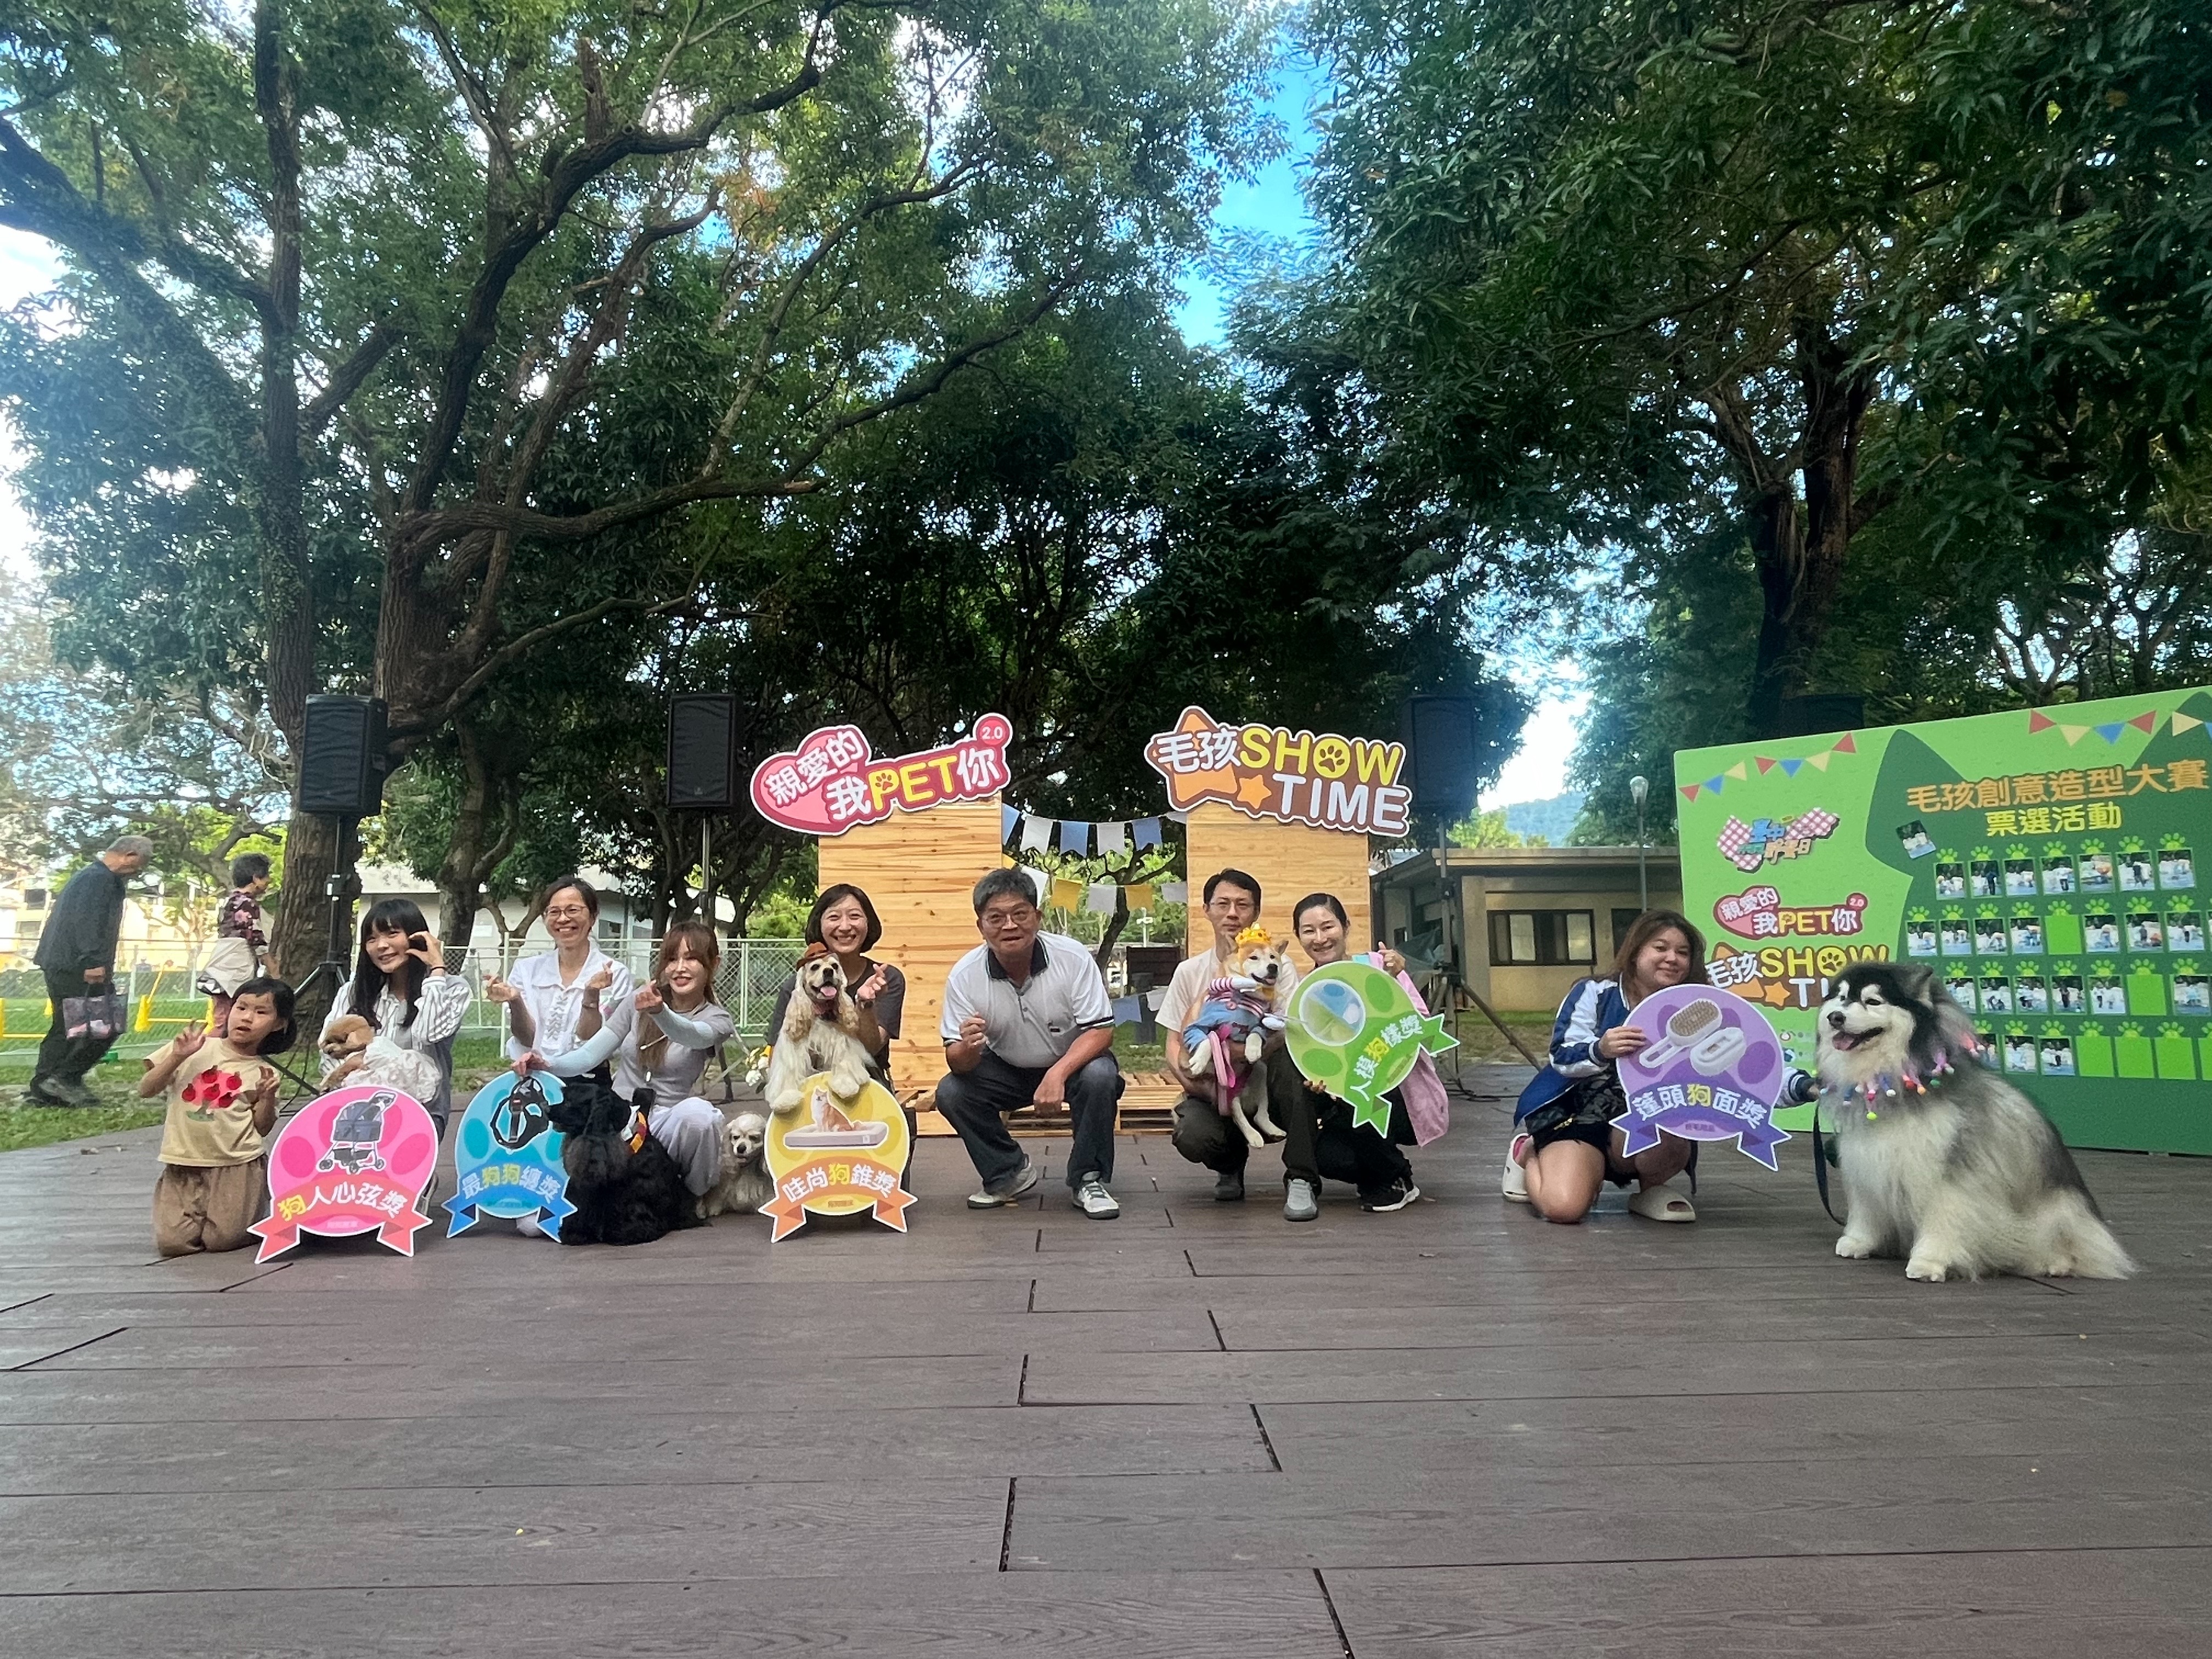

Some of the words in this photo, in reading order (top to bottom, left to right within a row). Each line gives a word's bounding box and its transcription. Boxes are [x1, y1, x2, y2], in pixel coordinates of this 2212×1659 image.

[981, 726, 1003, 741] 2.0
[765, 729, 864, 805] 親愛的
[1907, 760, 2210, 813] 毛孩創意造型大賽
[1272, 774, 1407, 830] TIME
[1985, 802, 2121, 837] 票選活動
[1720, 887, 1778, 921] 親愛的
